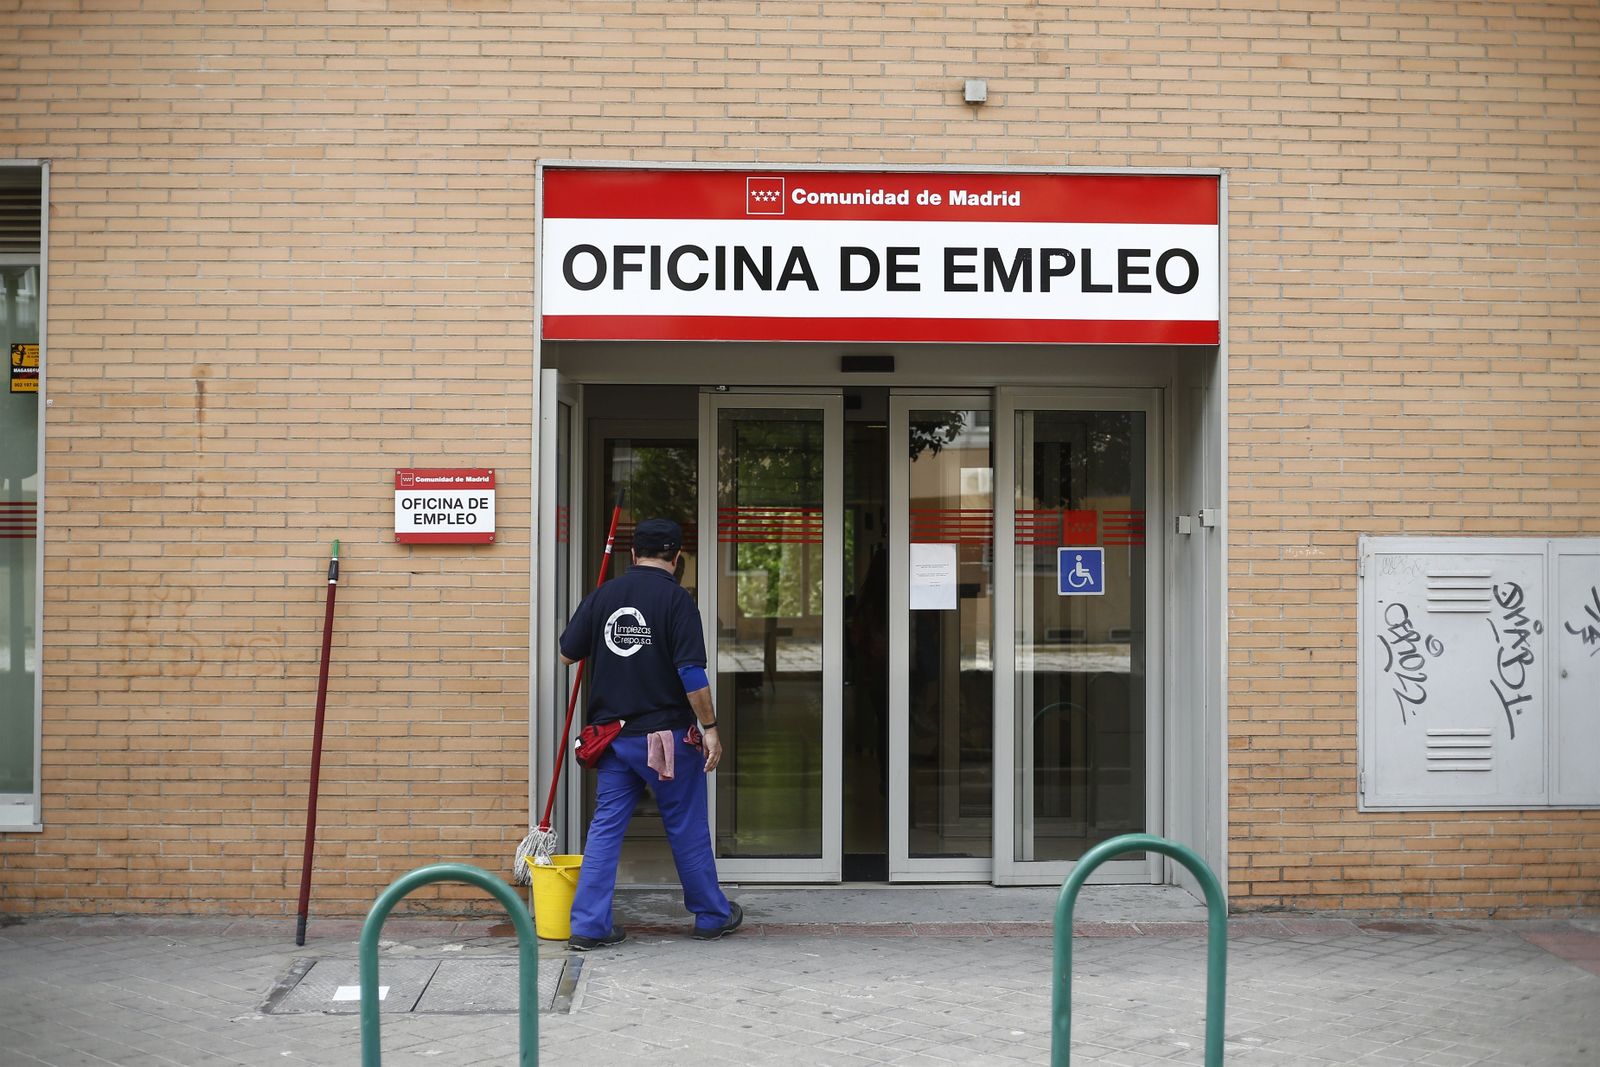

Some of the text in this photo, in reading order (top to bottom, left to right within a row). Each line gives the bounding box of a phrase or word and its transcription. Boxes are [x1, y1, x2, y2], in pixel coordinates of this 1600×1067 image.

[791, 188, 1021, 207] Comunidad de Madrid
[562, 243, 1200, 295] OFICINA DE EMPLEO
[401, 497, 489, 510] OFICINA DE
[413, 513, 477, 525] EMPLEO
[614, 621, 652, 637] Limpiezas
